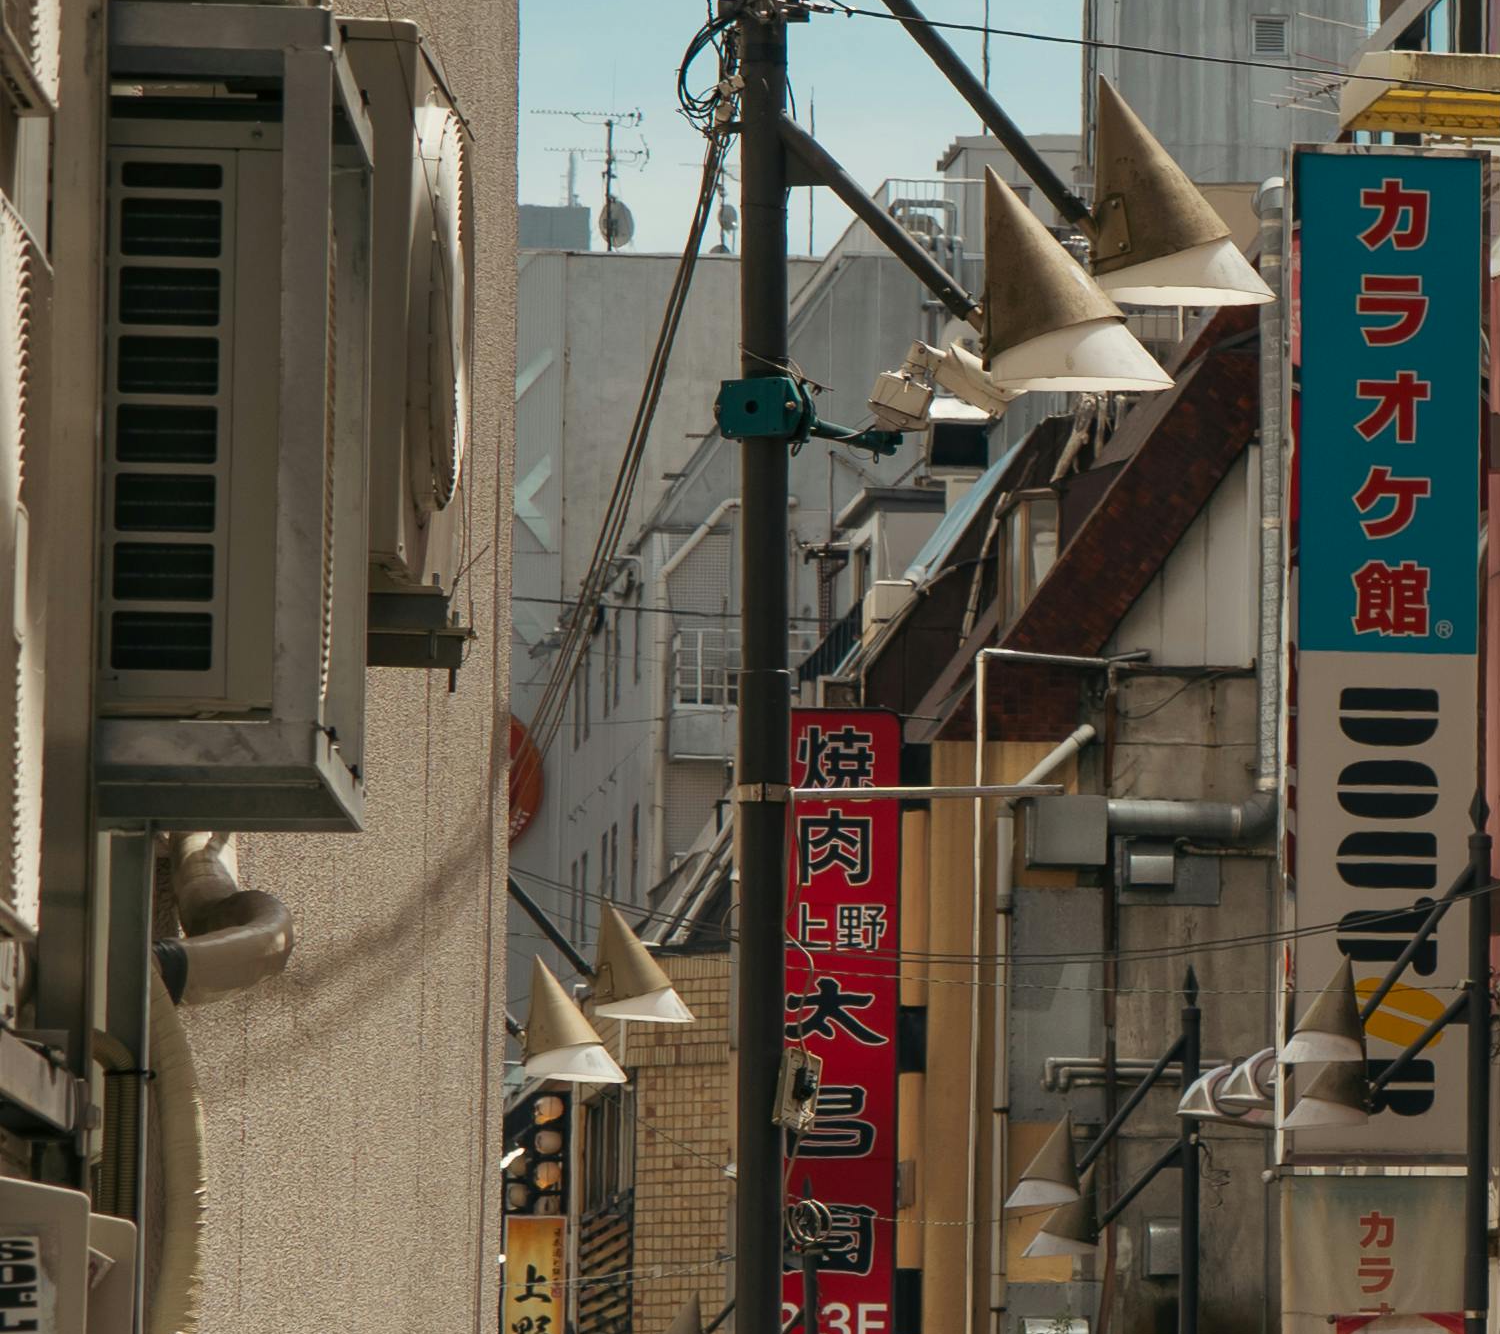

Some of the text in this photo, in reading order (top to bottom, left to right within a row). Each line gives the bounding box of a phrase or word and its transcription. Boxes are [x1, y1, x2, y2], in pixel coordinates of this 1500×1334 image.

[1352, 178, 1431, 638] カラオケ館
[797, 725, 875, 886] 焼肉
[798, 903, 888, 952] 上野
[1358, 1211, 1396, 1315] カラ
